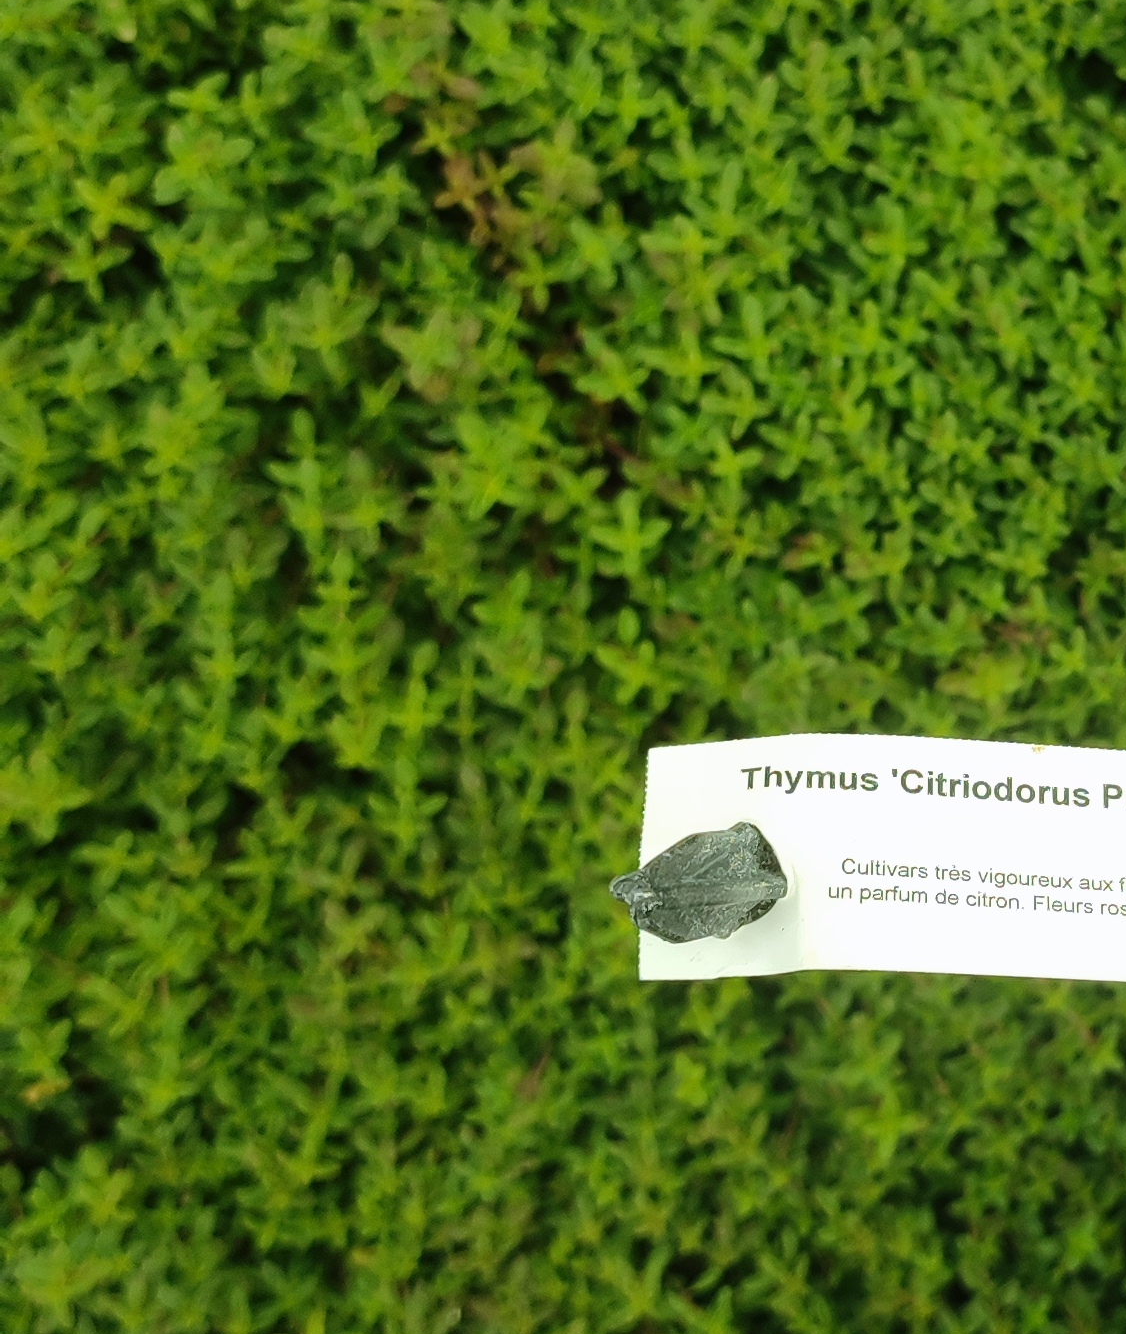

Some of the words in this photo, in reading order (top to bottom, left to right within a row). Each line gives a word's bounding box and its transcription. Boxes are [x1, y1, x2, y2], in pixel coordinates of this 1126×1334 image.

[741, 766, 878, 794] Thymus
[892, 769, 1090, 807] 'Citriodorus
[842, 858, 928, 878] Cultivars
[935, 865, 971, 881] très
[978, 868, 1072, 889] vigoureux
[1079, 878, 1113, 891] aux
[829, 887, 852, 899] un
[860, 886, 927, 904] parfum
[935, 889, 959, 905] de
[966, 891, 1024, 909] citron.
[1034, 895, 1093, 913] Fleurs
